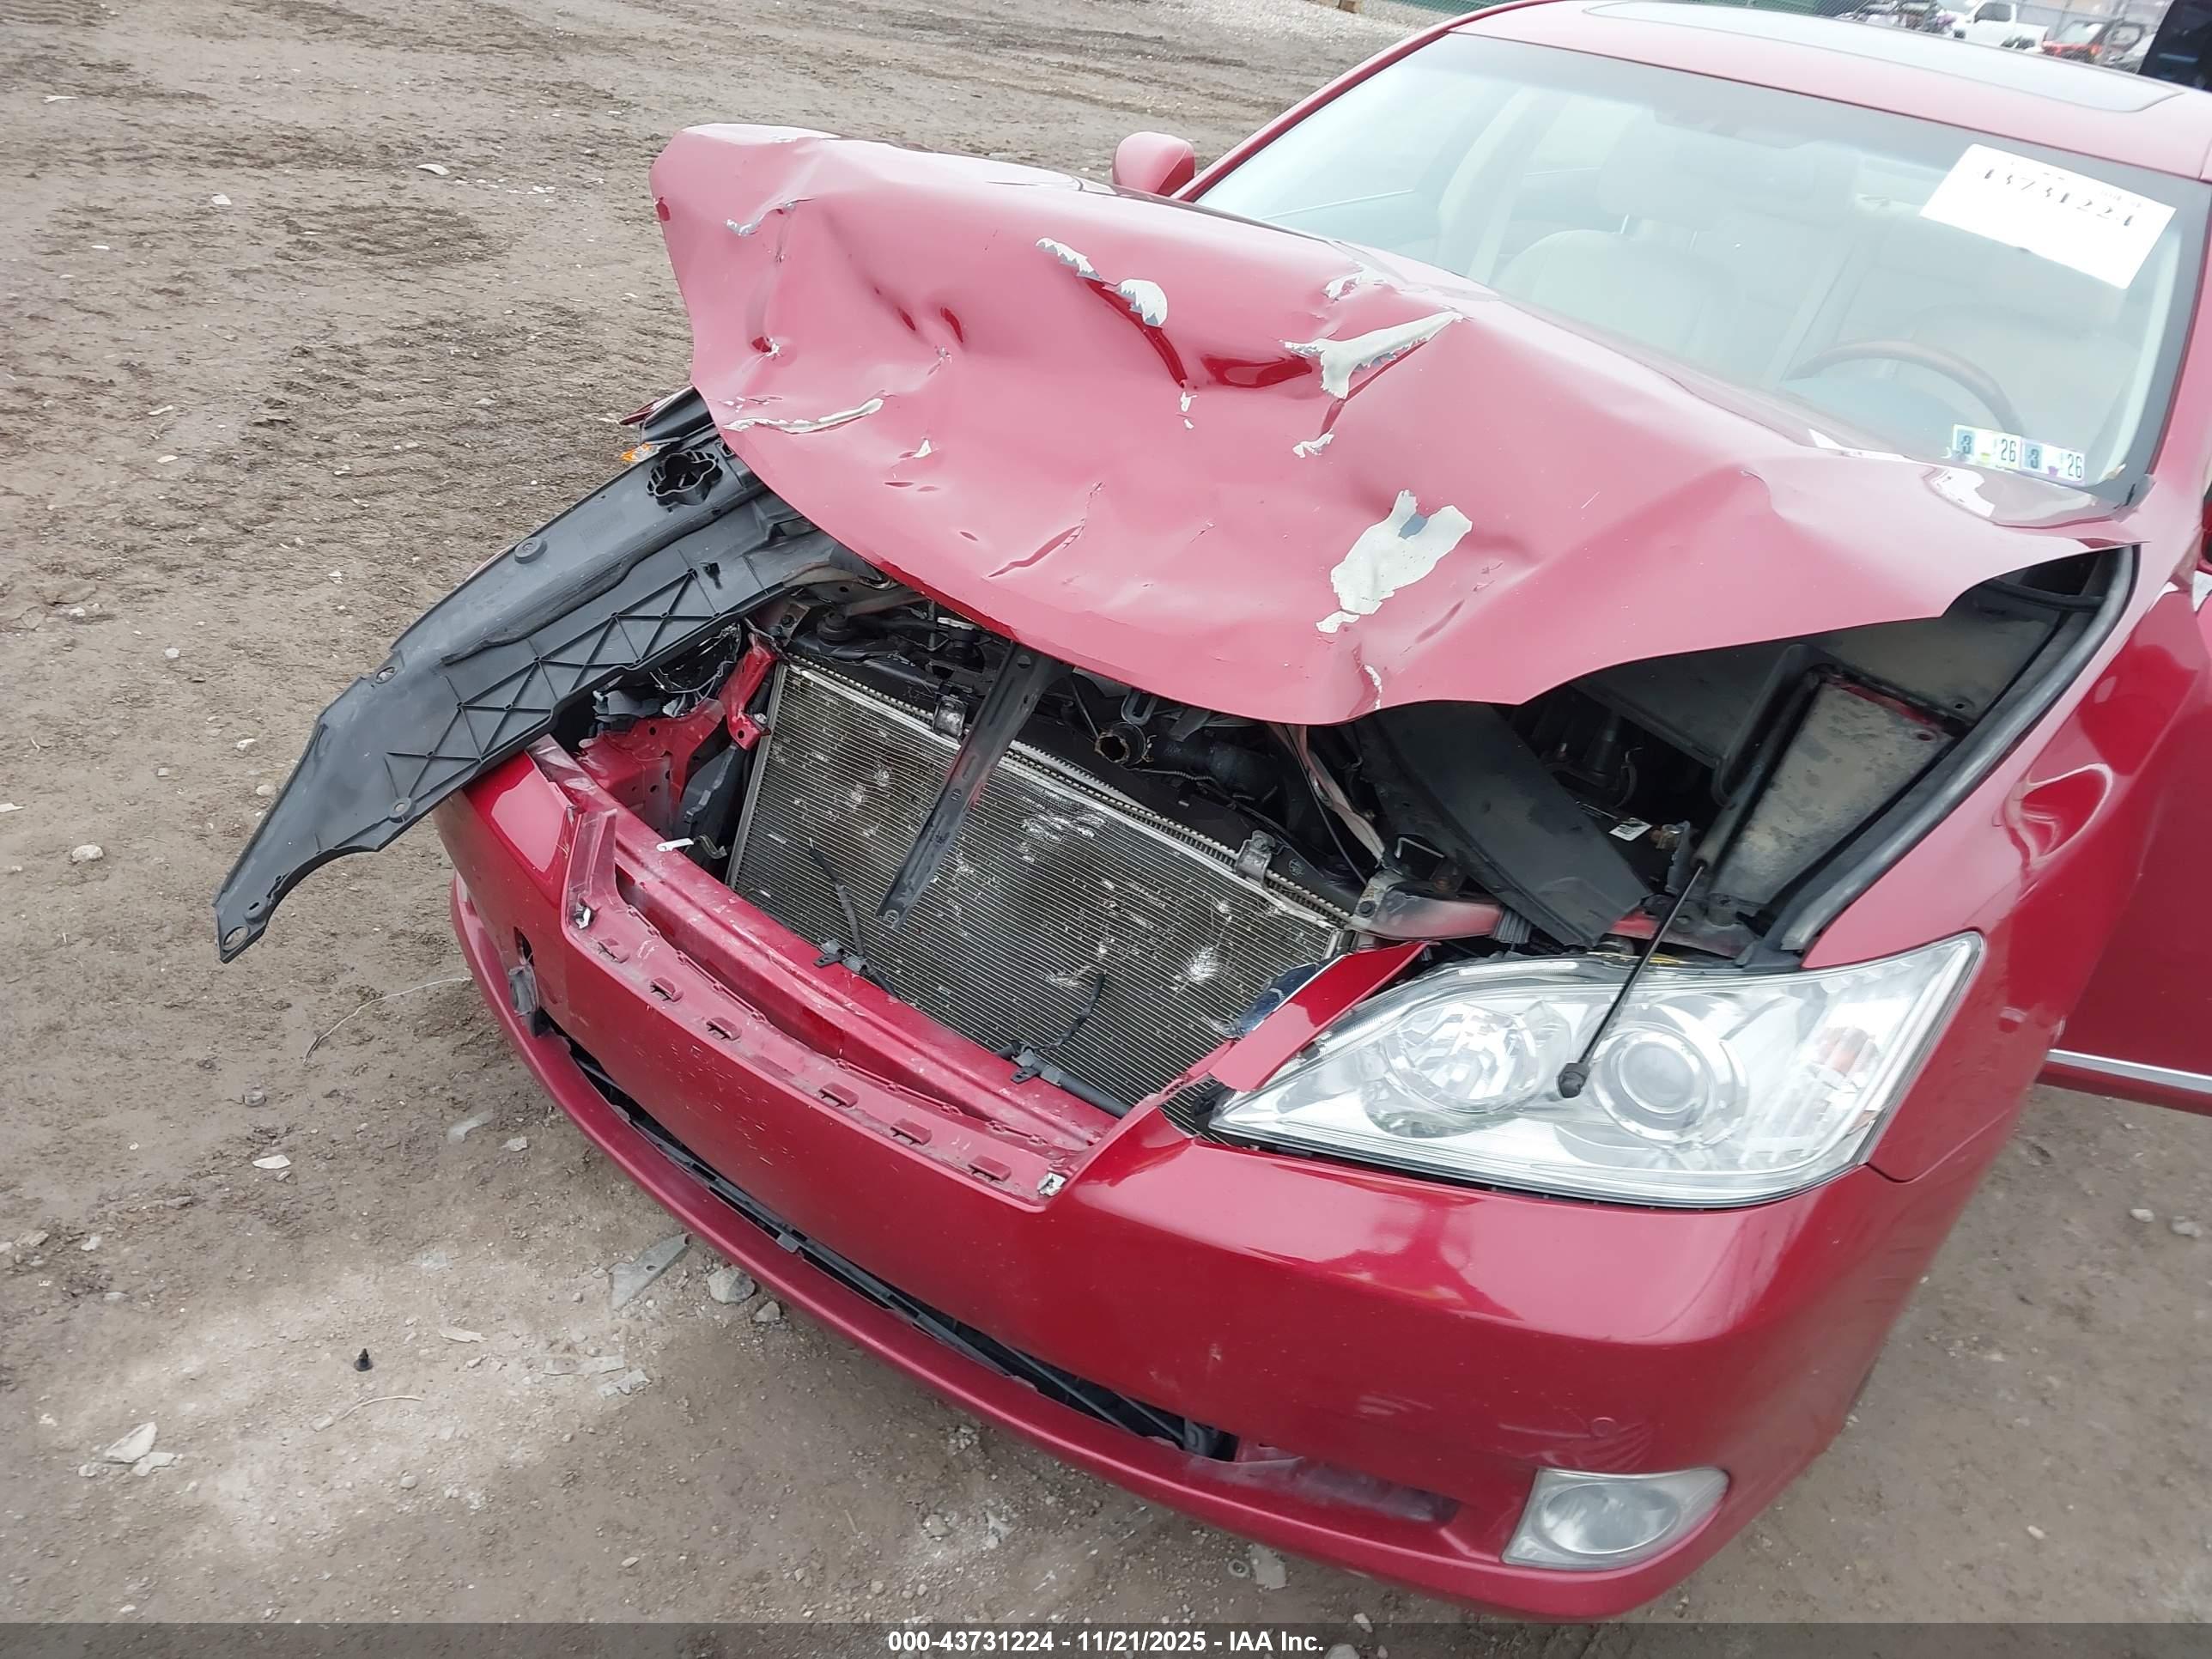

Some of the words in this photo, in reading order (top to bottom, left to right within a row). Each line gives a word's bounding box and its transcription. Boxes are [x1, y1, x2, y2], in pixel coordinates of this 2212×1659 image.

[2001, 439, 2017, 463] 26
[2030, 448, 2039, 469] 3
[2067, 453, 2082, 478] 26
